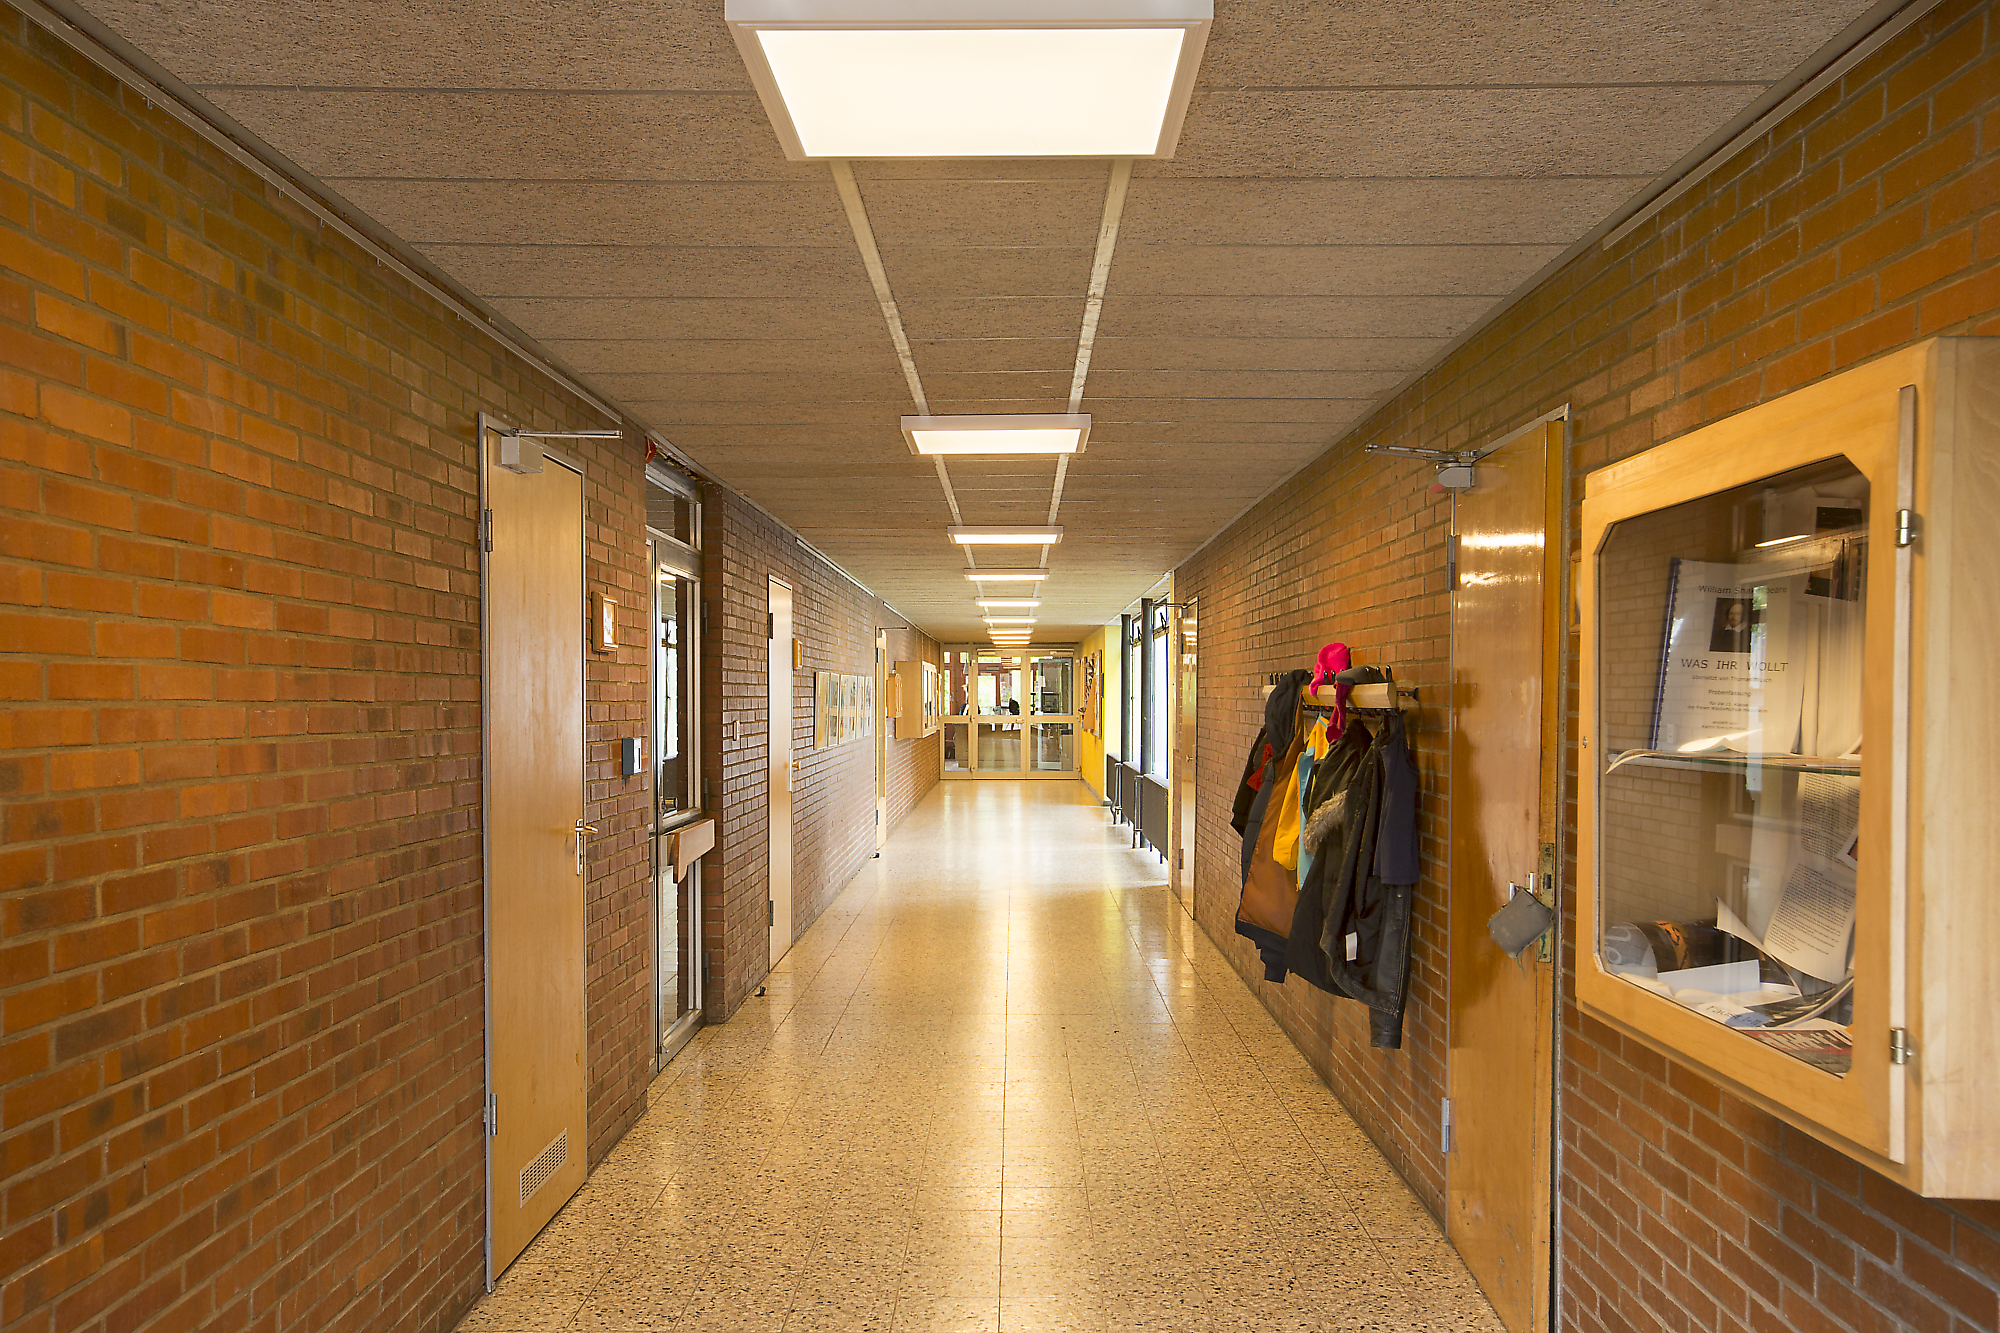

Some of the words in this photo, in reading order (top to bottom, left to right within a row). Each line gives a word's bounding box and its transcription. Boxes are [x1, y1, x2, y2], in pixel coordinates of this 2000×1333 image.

[1698, 585, 1731, 594] William
[1734, 586, 1787, 595] Shaeare
[1681, 658, 1709, 669] WAS
[1716, 660, 1738, 670] IHR
[1746, 661, 1789, 672] WOLLT
